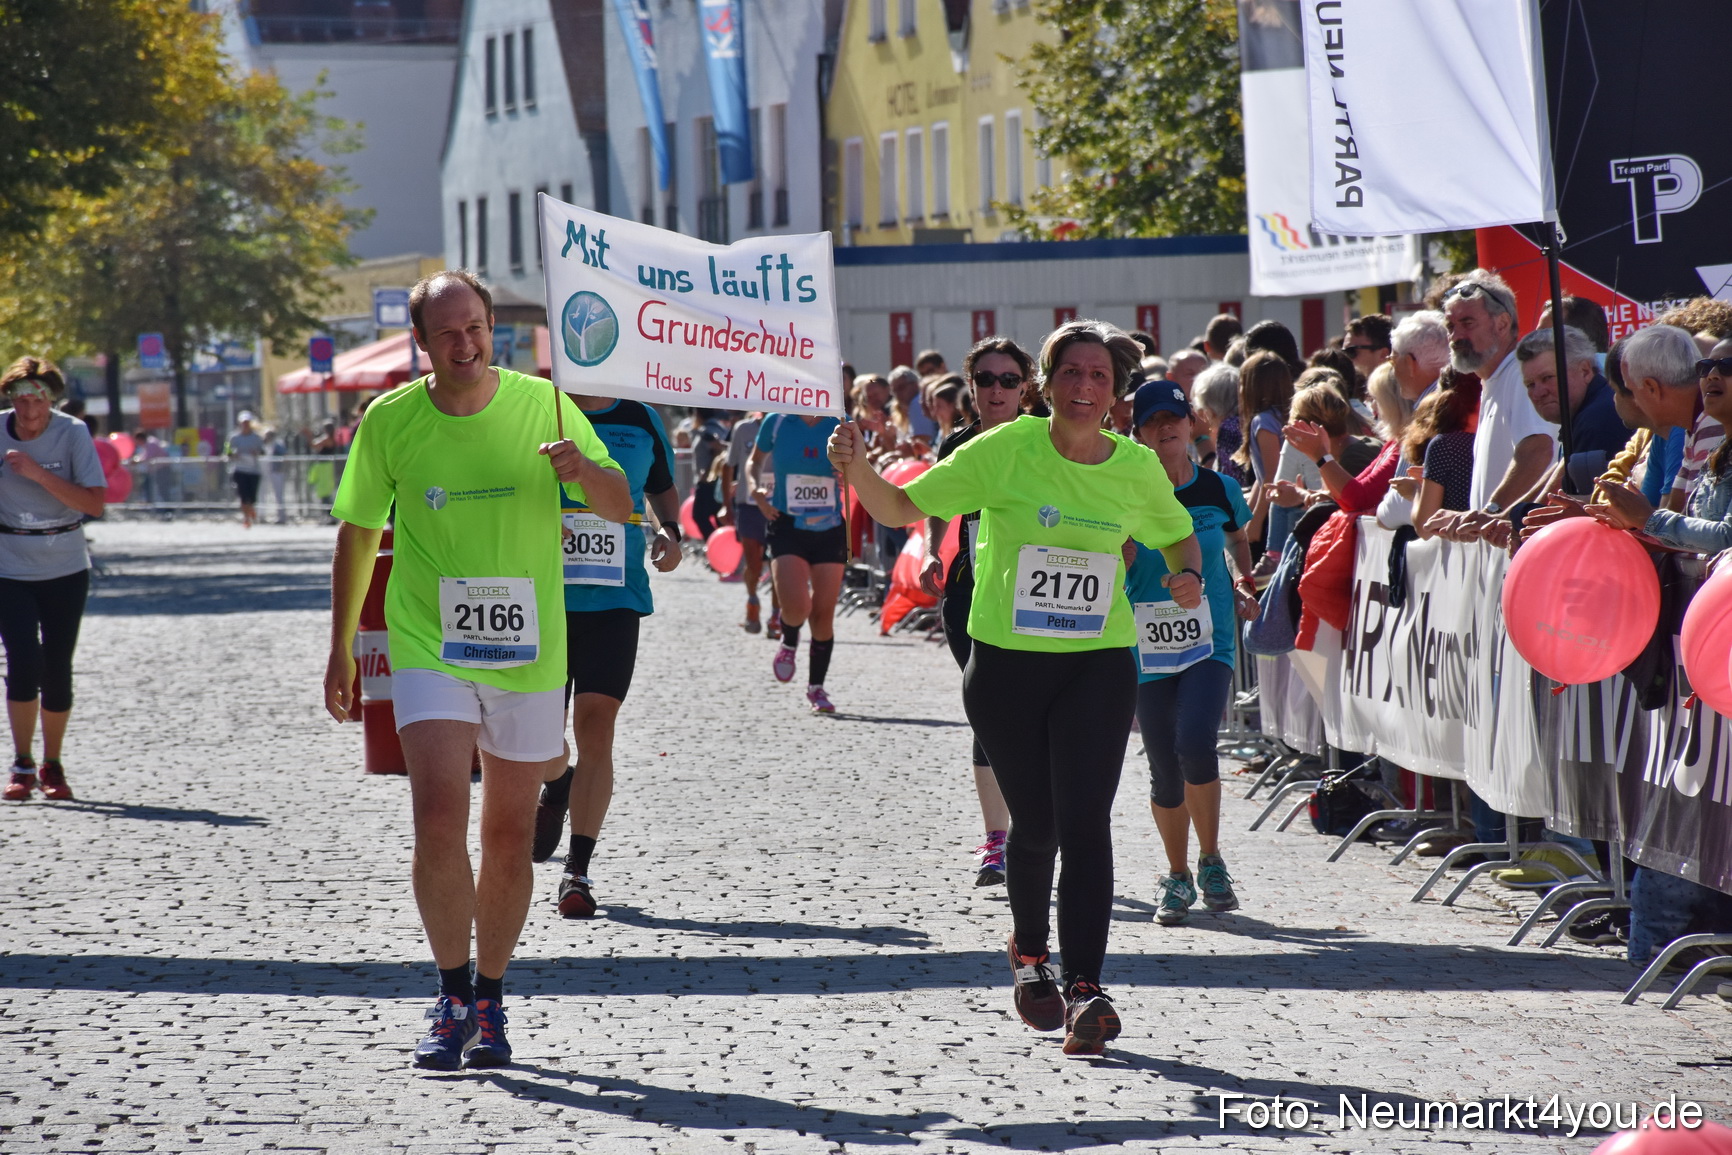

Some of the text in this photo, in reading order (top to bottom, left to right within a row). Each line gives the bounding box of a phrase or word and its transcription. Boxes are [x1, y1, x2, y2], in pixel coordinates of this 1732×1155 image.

[1617, 165, 1645, 175] Team
[561, 219, 817, 305] Mit uns läufts
[1602, 304, 1632, 323] HE
[637, 300, 815, 360] Grundschule
[646, 361, 831, 408] Haus St. Marien
[794, 486, 828, 500] 2090
[574, 519, 607, 528] BOCK
[563, 533, 615, 556] 3035
[1047, 554, 1089, 566] BOCK
[467, 586, 510, 596] BOCK
[1029, 570, 1099, 602] 2170
[1056, 603, 1084, 611] Neumarkt
[454, 604, 524, 631] 2166
[1047, 615, 1076, 628] Petra
[1146, 618, 1201, 643] 3039
[464, 645, 516, 660] Christian
